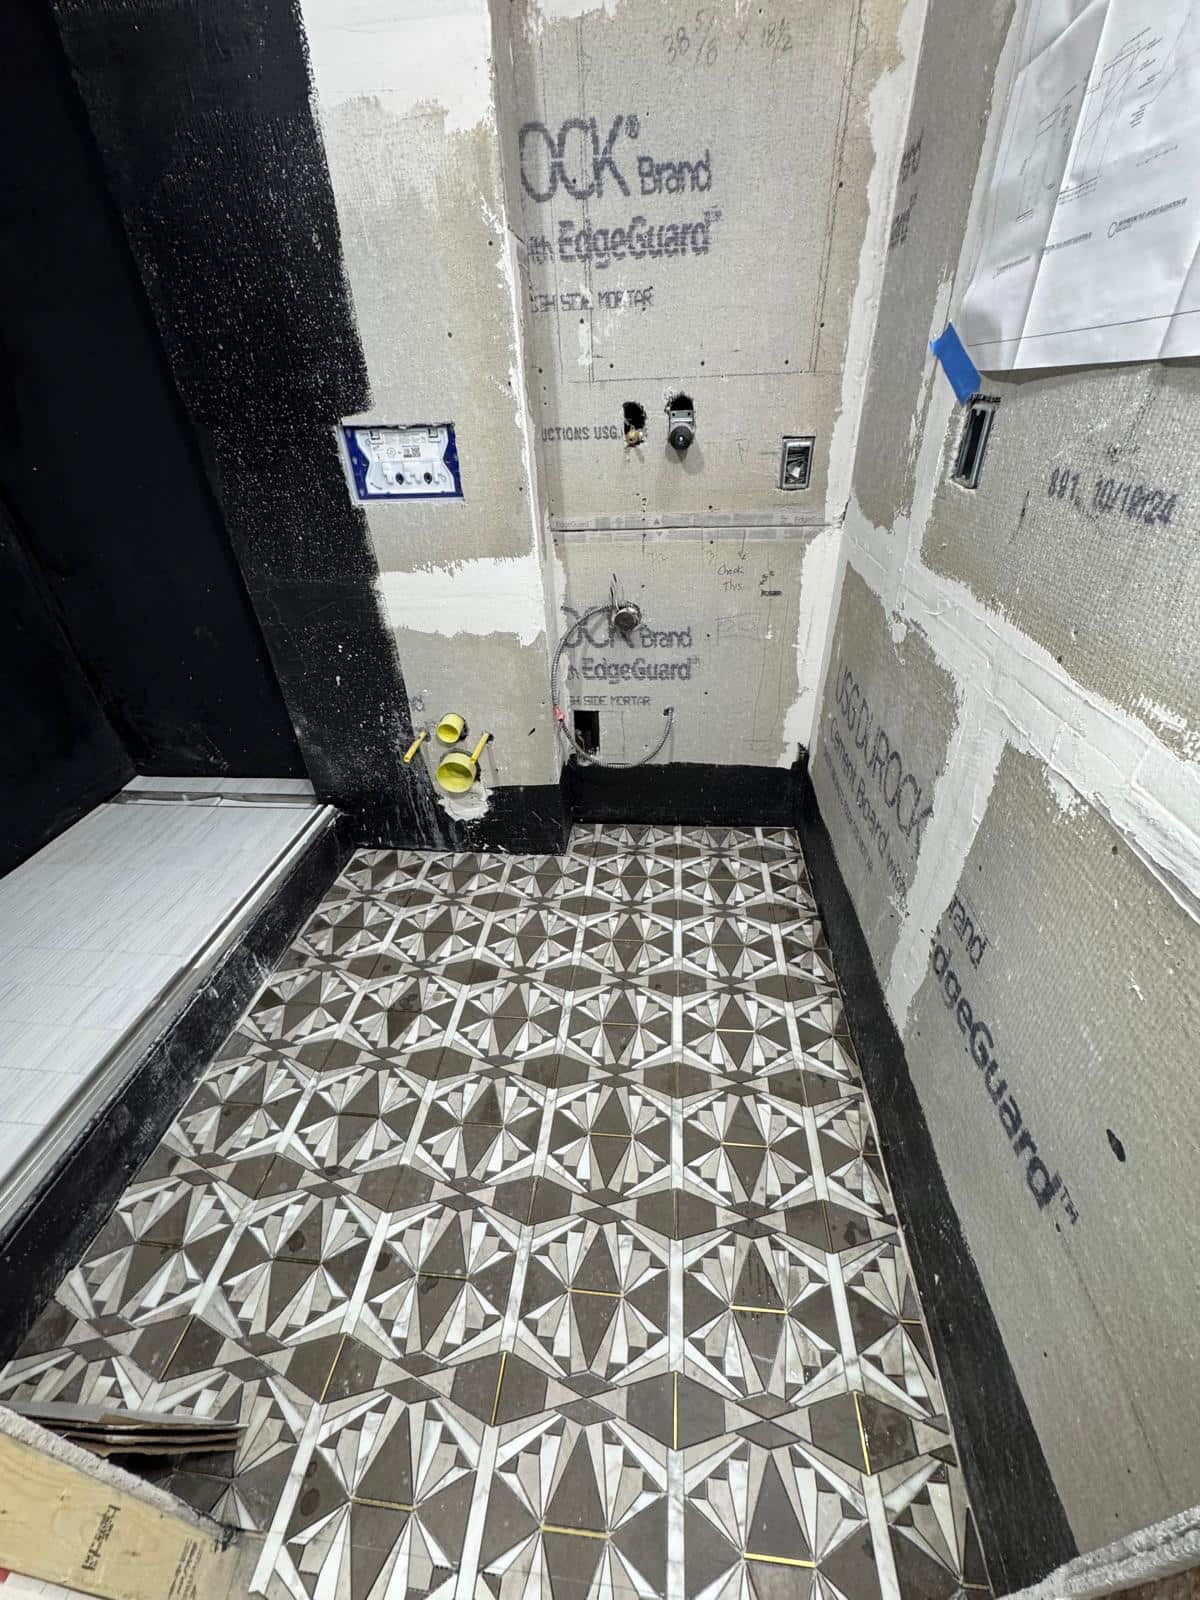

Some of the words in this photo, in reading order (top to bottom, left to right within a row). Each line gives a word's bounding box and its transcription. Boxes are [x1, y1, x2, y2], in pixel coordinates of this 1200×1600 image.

[637, 149, 712, 196] Brand
[593, 425, 624, 440] USG.
[639, 626, 693, 649] Brand
[830, 717, 857, 793] Cement
[856, 776, 890, 858] Board
